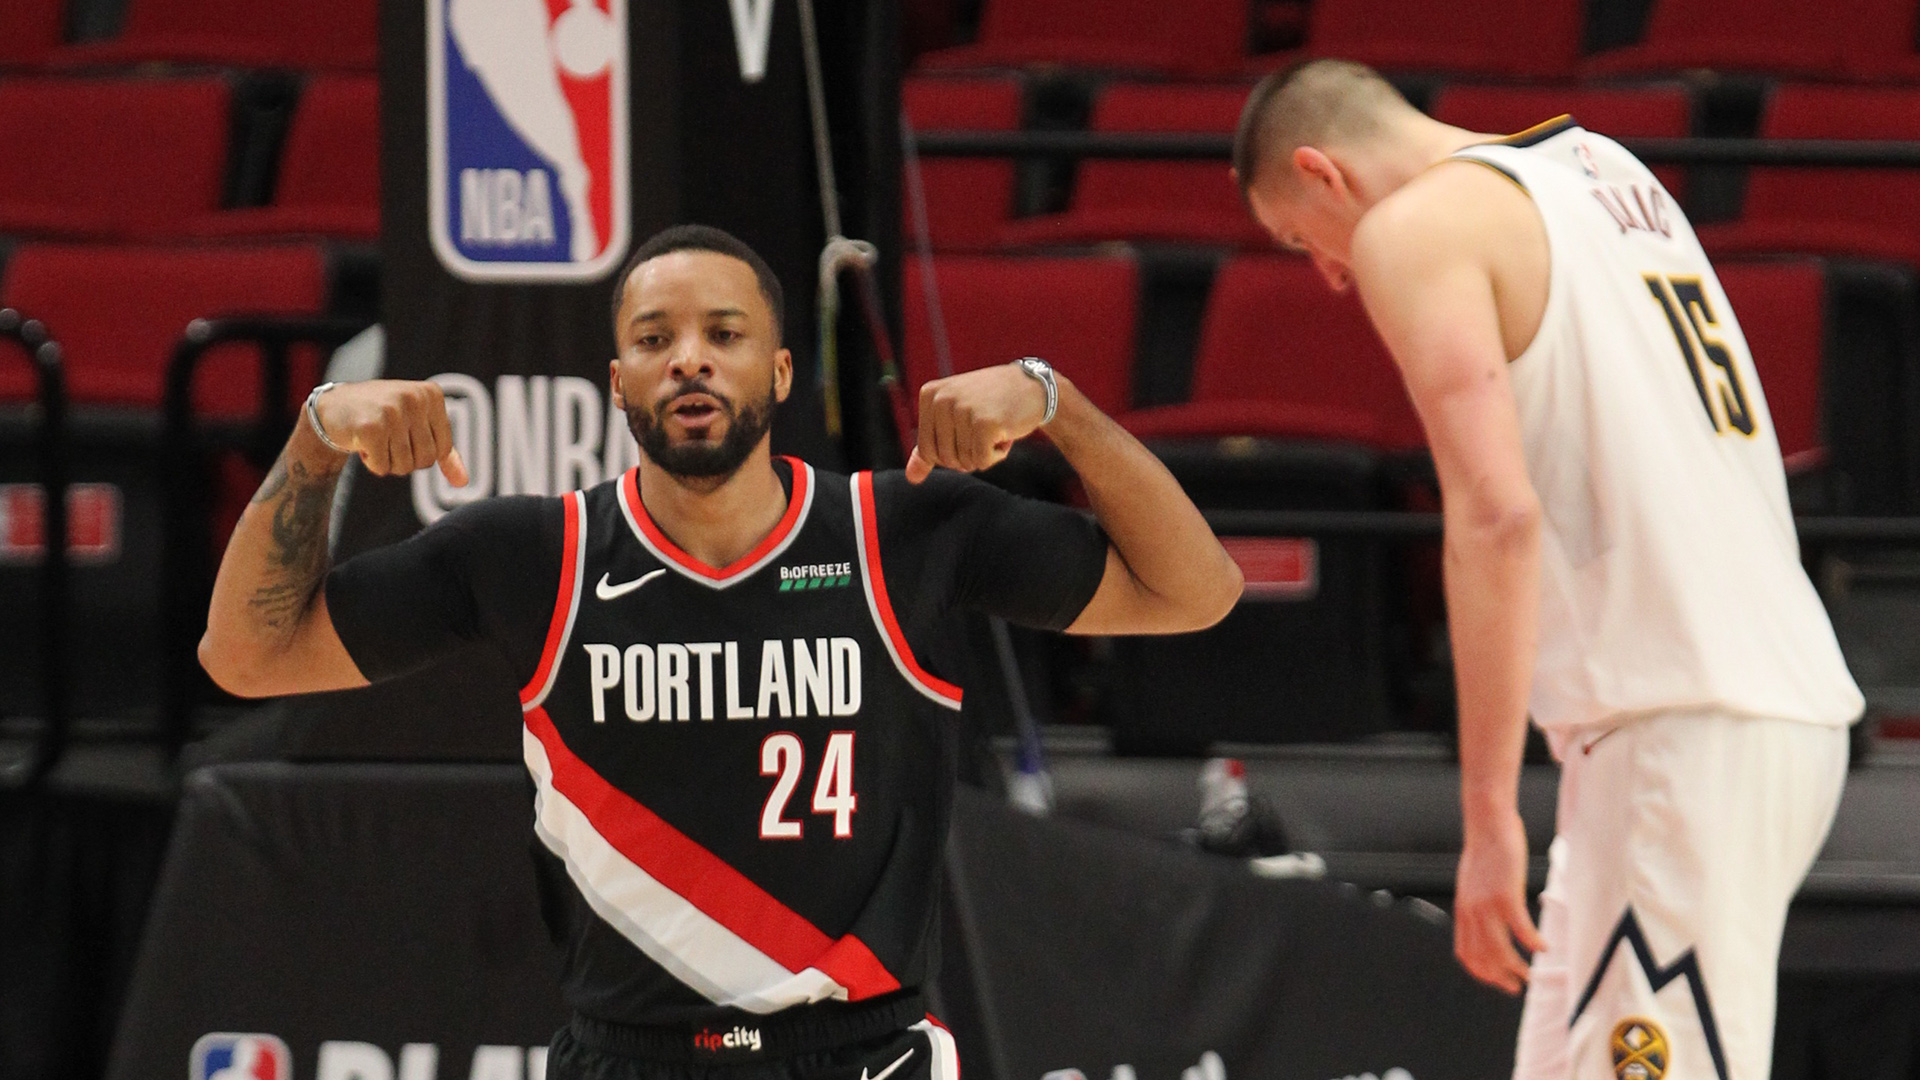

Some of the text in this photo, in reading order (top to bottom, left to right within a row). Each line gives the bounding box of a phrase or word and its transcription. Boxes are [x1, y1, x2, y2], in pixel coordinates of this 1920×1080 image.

[460, 168, 555, 244] NBA
[1640, 270, 1758, 439] 15
[583, 637, 861, 722] PORTLAND
[759, 730, 857, 839] 24
